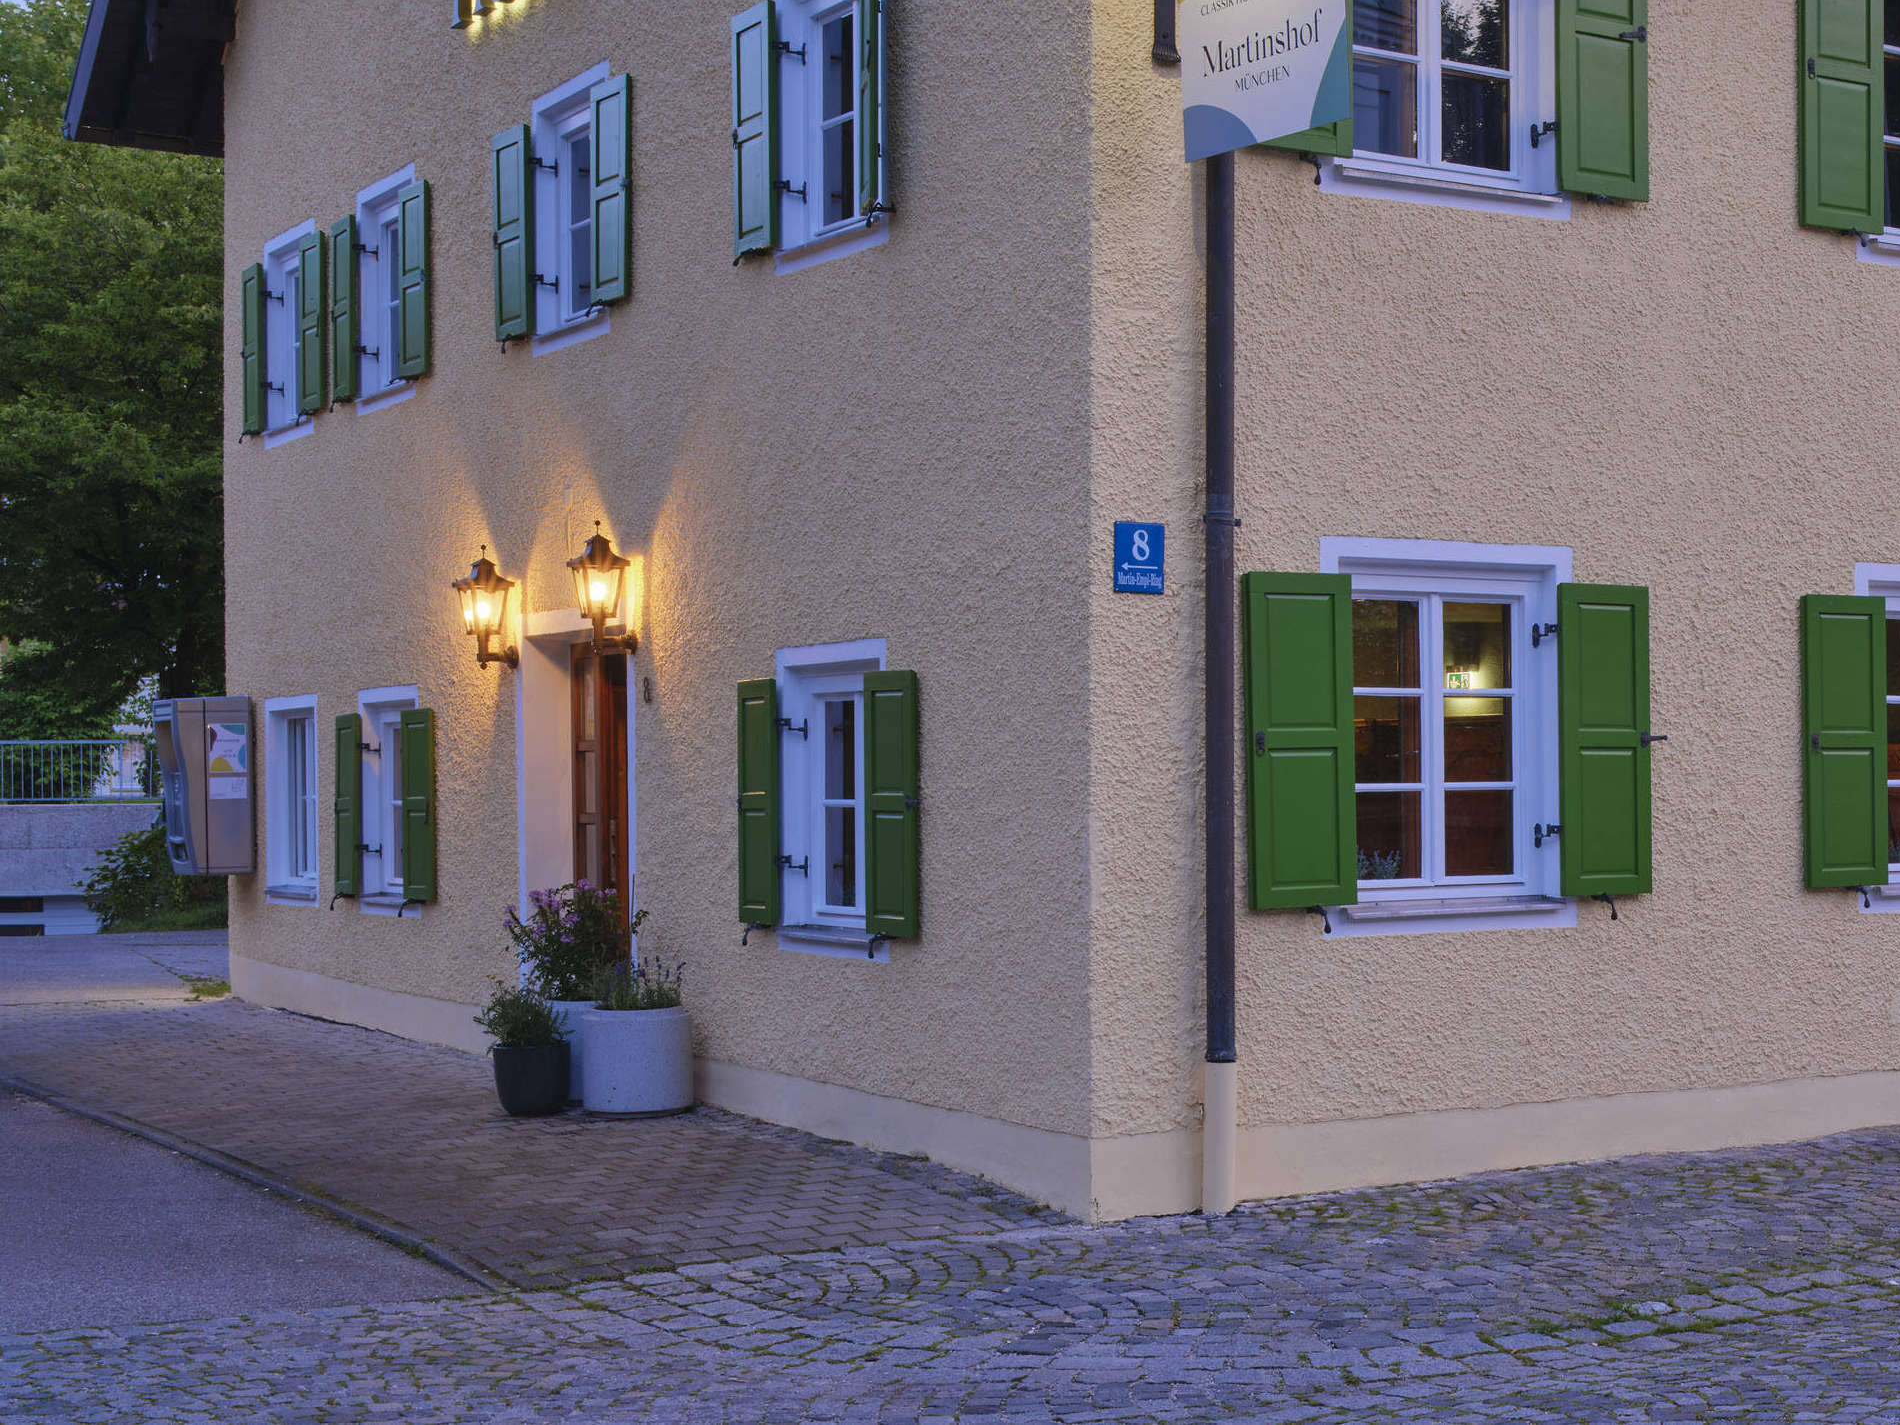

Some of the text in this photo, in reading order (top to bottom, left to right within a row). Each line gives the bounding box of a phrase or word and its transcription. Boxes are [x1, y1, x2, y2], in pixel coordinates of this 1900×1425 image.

[1202, 7, 1322, 77] Martinshof
[1234, 65, 1290, 92] MÜNCHEN
[1131, 529, 1150, 561] 8
